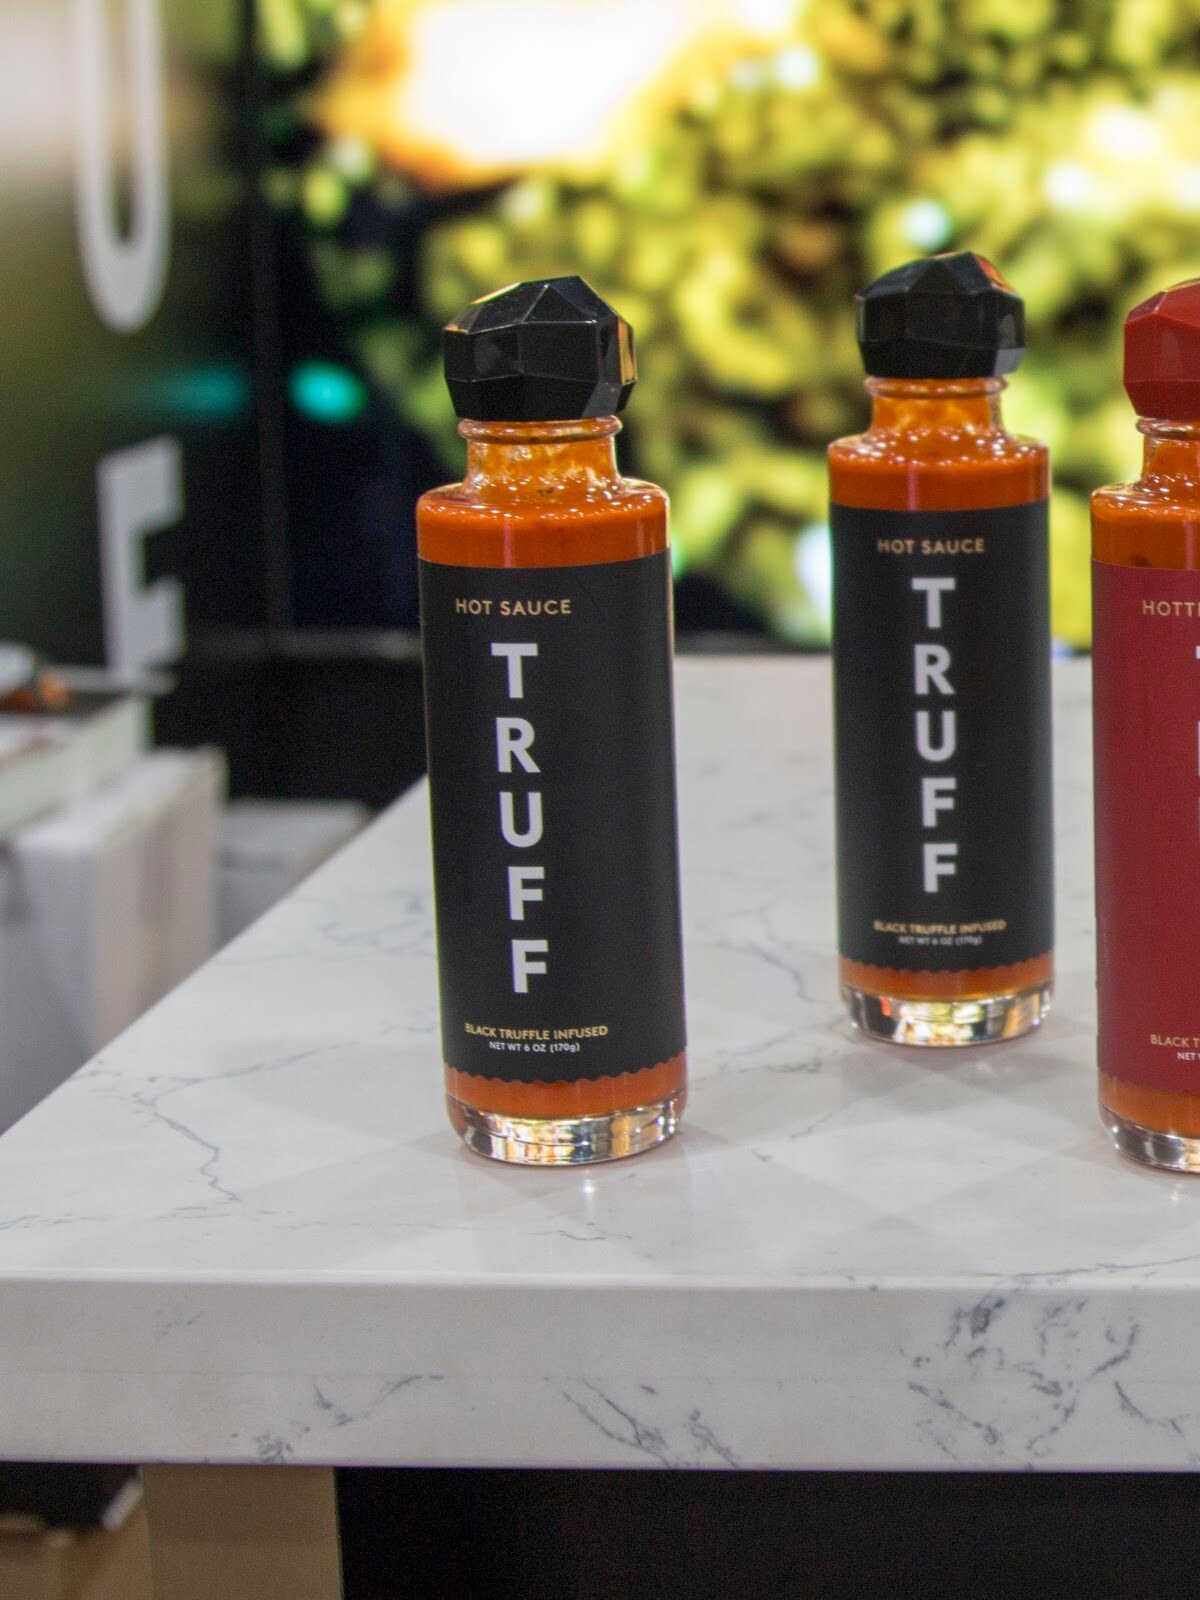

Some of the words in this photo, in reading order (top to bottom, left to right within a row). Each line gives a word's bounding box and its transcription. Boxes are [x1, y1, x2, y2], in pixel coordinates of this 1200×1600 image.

[876, 538, 915, 555] HOT
[920, 537, 985, 555] SAUCE
[454, 598, 493, 616] HOT
[498, 599, 573, 616] SAUCE
[910, 576, 960, 894] TRUFF
[489, 641, 550, 995] TRUFF
[464, 1022, 497, 1038] BLACK
[499, 1028, 550, 1040] TRUFFLE
[553, 1025, 608, 1039] INFUSED
[489, 1041, 506, 1051] NET
[507, 1042, 522, 1052] WT
[524, 1043, 531, 1052] 6
[532, 1043, 547, 1053] OZ
[549, 1042, 581, 1054] (170g)
[1150, 1033, 1190, 1048] BLACK
[1177, 1052, 1195, 1061] NET
